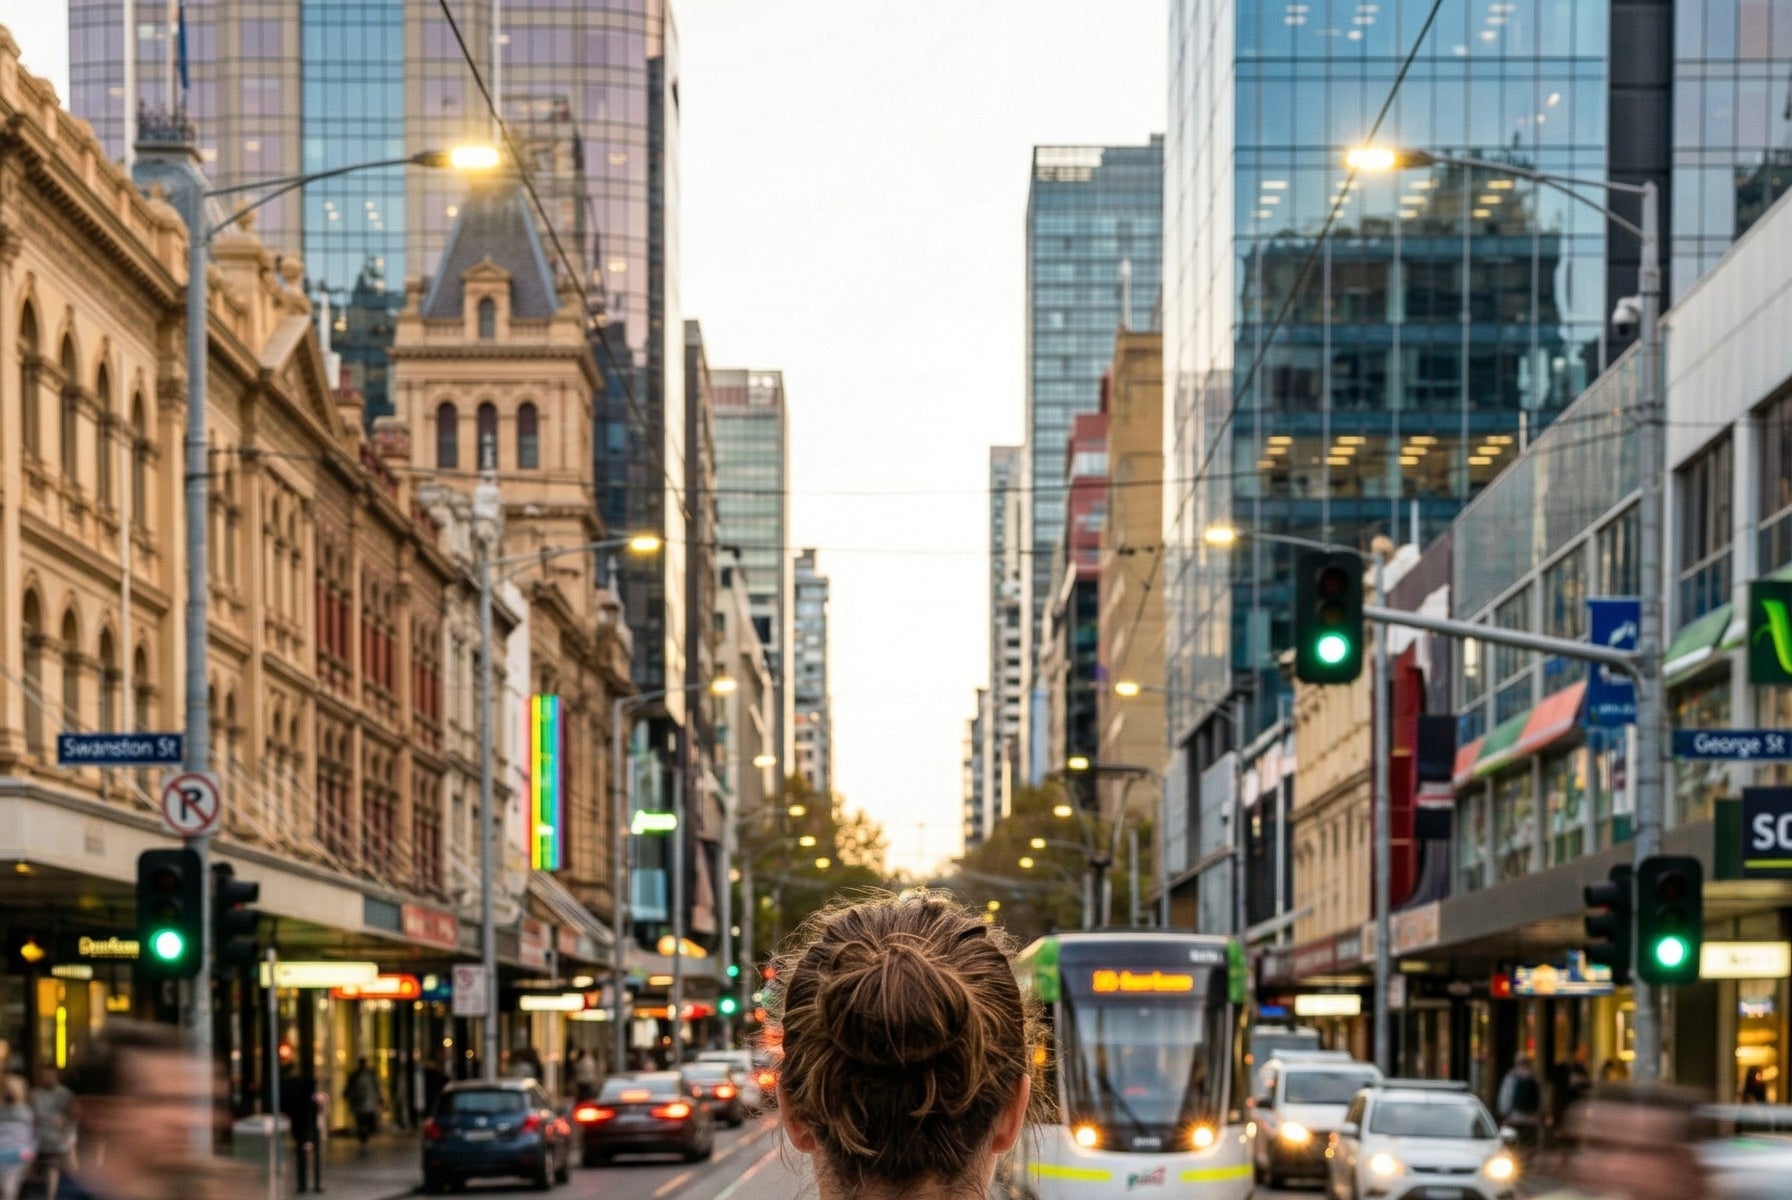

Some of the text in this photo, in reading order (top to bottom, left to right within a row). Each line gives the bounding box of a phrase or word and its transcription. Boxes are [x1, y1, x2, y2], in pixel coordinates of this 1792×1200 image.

[157, 737, 178, 757] St
[1694, 732, 1785, 757] George St
